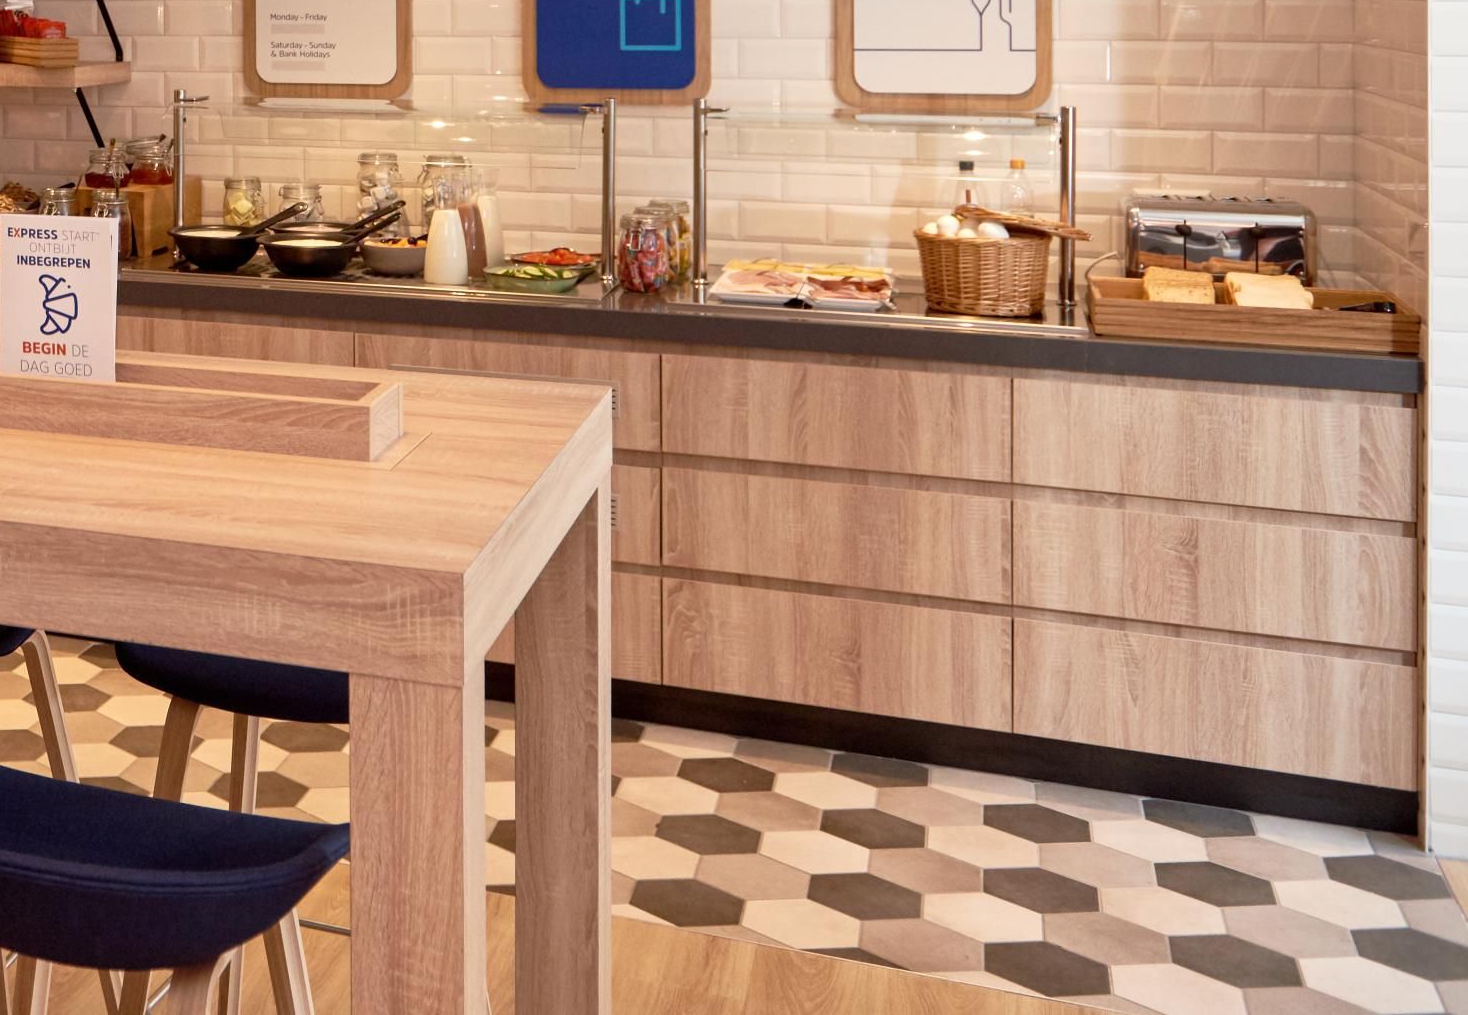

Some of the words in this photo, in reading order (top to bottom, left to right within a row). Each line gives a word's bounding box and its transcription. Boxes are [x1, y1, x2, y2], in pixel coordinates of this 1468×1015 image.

[270, 13, 299, 22] Monday
[305, 13, 327, 22] Friday
[270, 41, 303, 50] Saturday
[309, 41, 336, 50] Sunday
[270, 50, 277, 58] &
[279, 50, 297, 58] Bank
[300, 50, 331, 59] Holidays
[7, 227, 58, 240] EXPRESS
[29, 242, 76, 255] ONTBIJT
[17, 255, 91, 269] INBEGREPEN
[22, 341, 67, 356] BEGIN
[72, 344, 89, 358] DE
[20, 359, 50, 374] DAG
[54, 362, 93, 377] GOED
